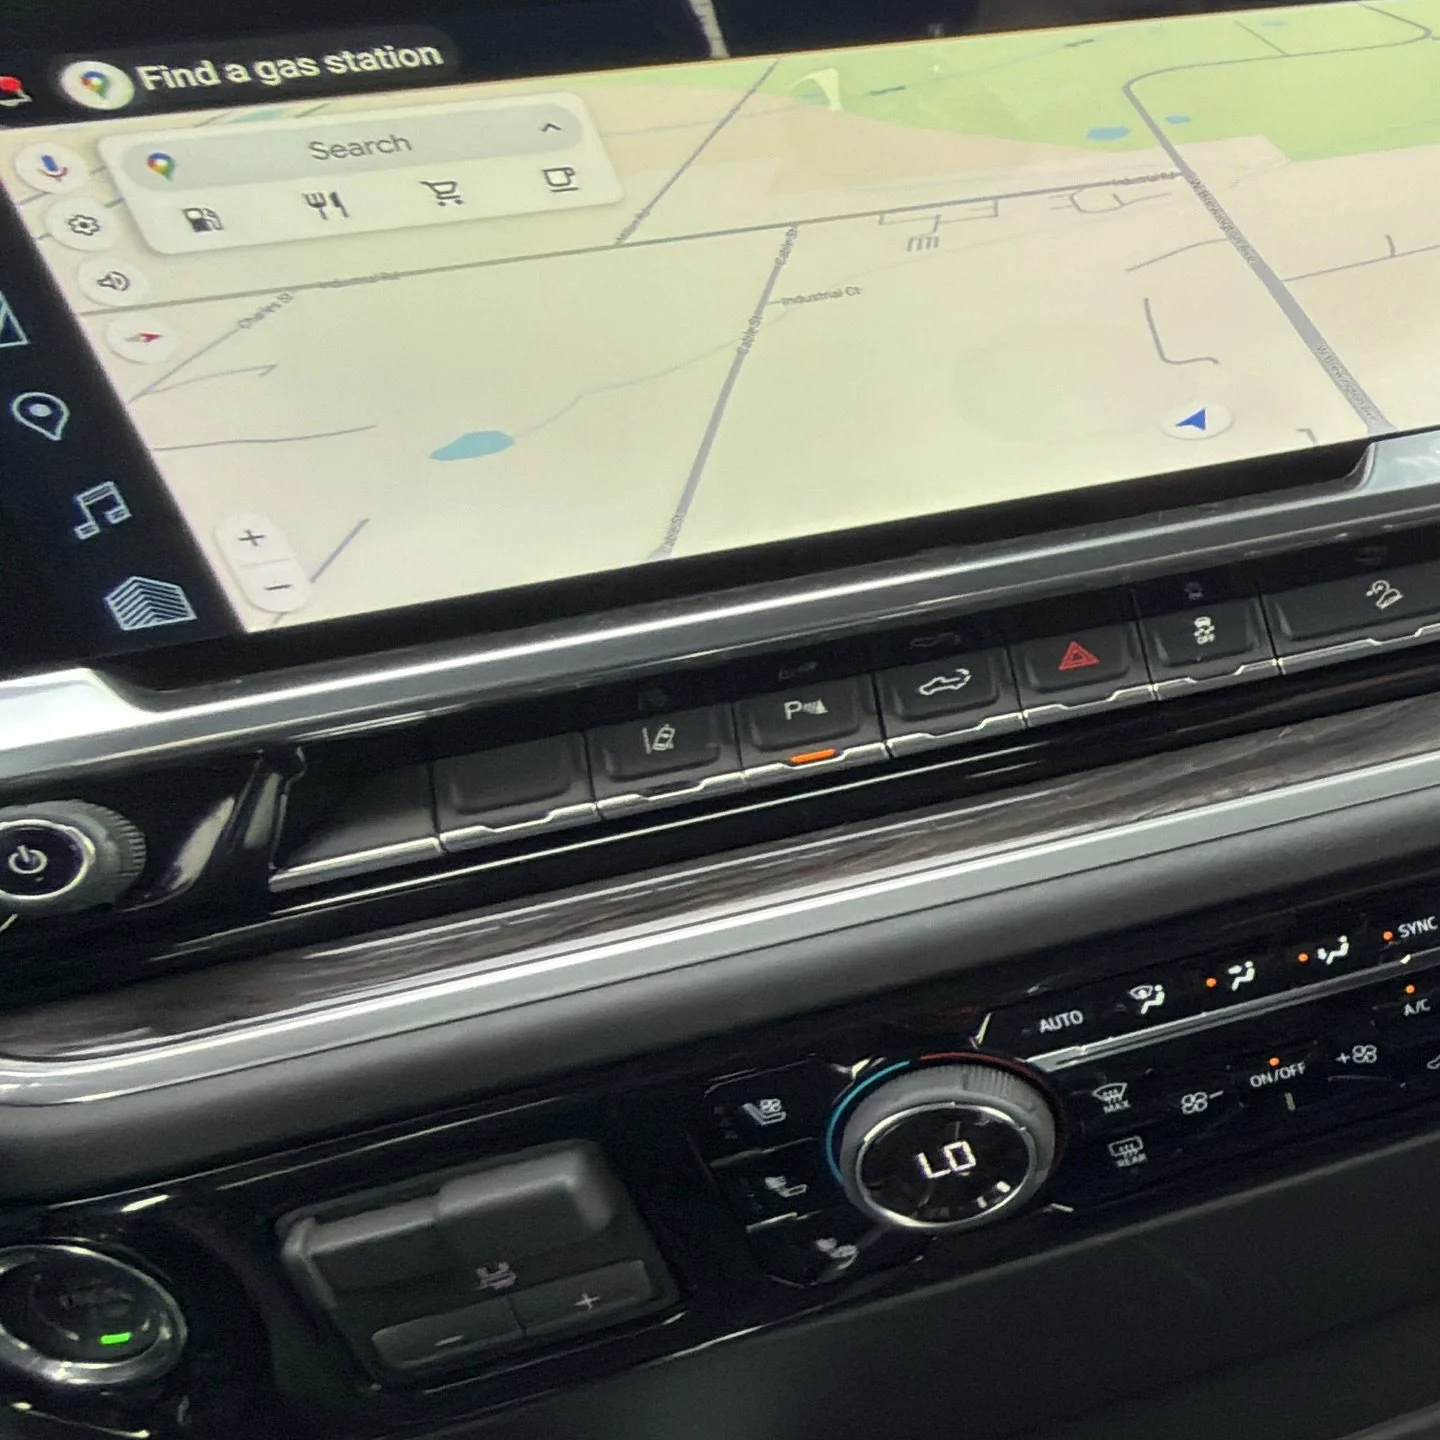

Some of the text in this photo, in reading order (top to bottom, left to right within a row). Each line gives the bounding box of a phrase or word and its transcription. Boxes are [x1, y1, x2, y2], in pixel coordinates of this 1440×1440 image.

[135, 44, 445, 92] Find a gas station
[308, 134, 414, 162] Search
[1397, 915, 1439, 939] SYNC
[1402, 998, 1431, 1017] A/C
[1039, 1009, 1084, 1034] AUTO
[1249, 1061, 1306, 1089] ON/OFF
